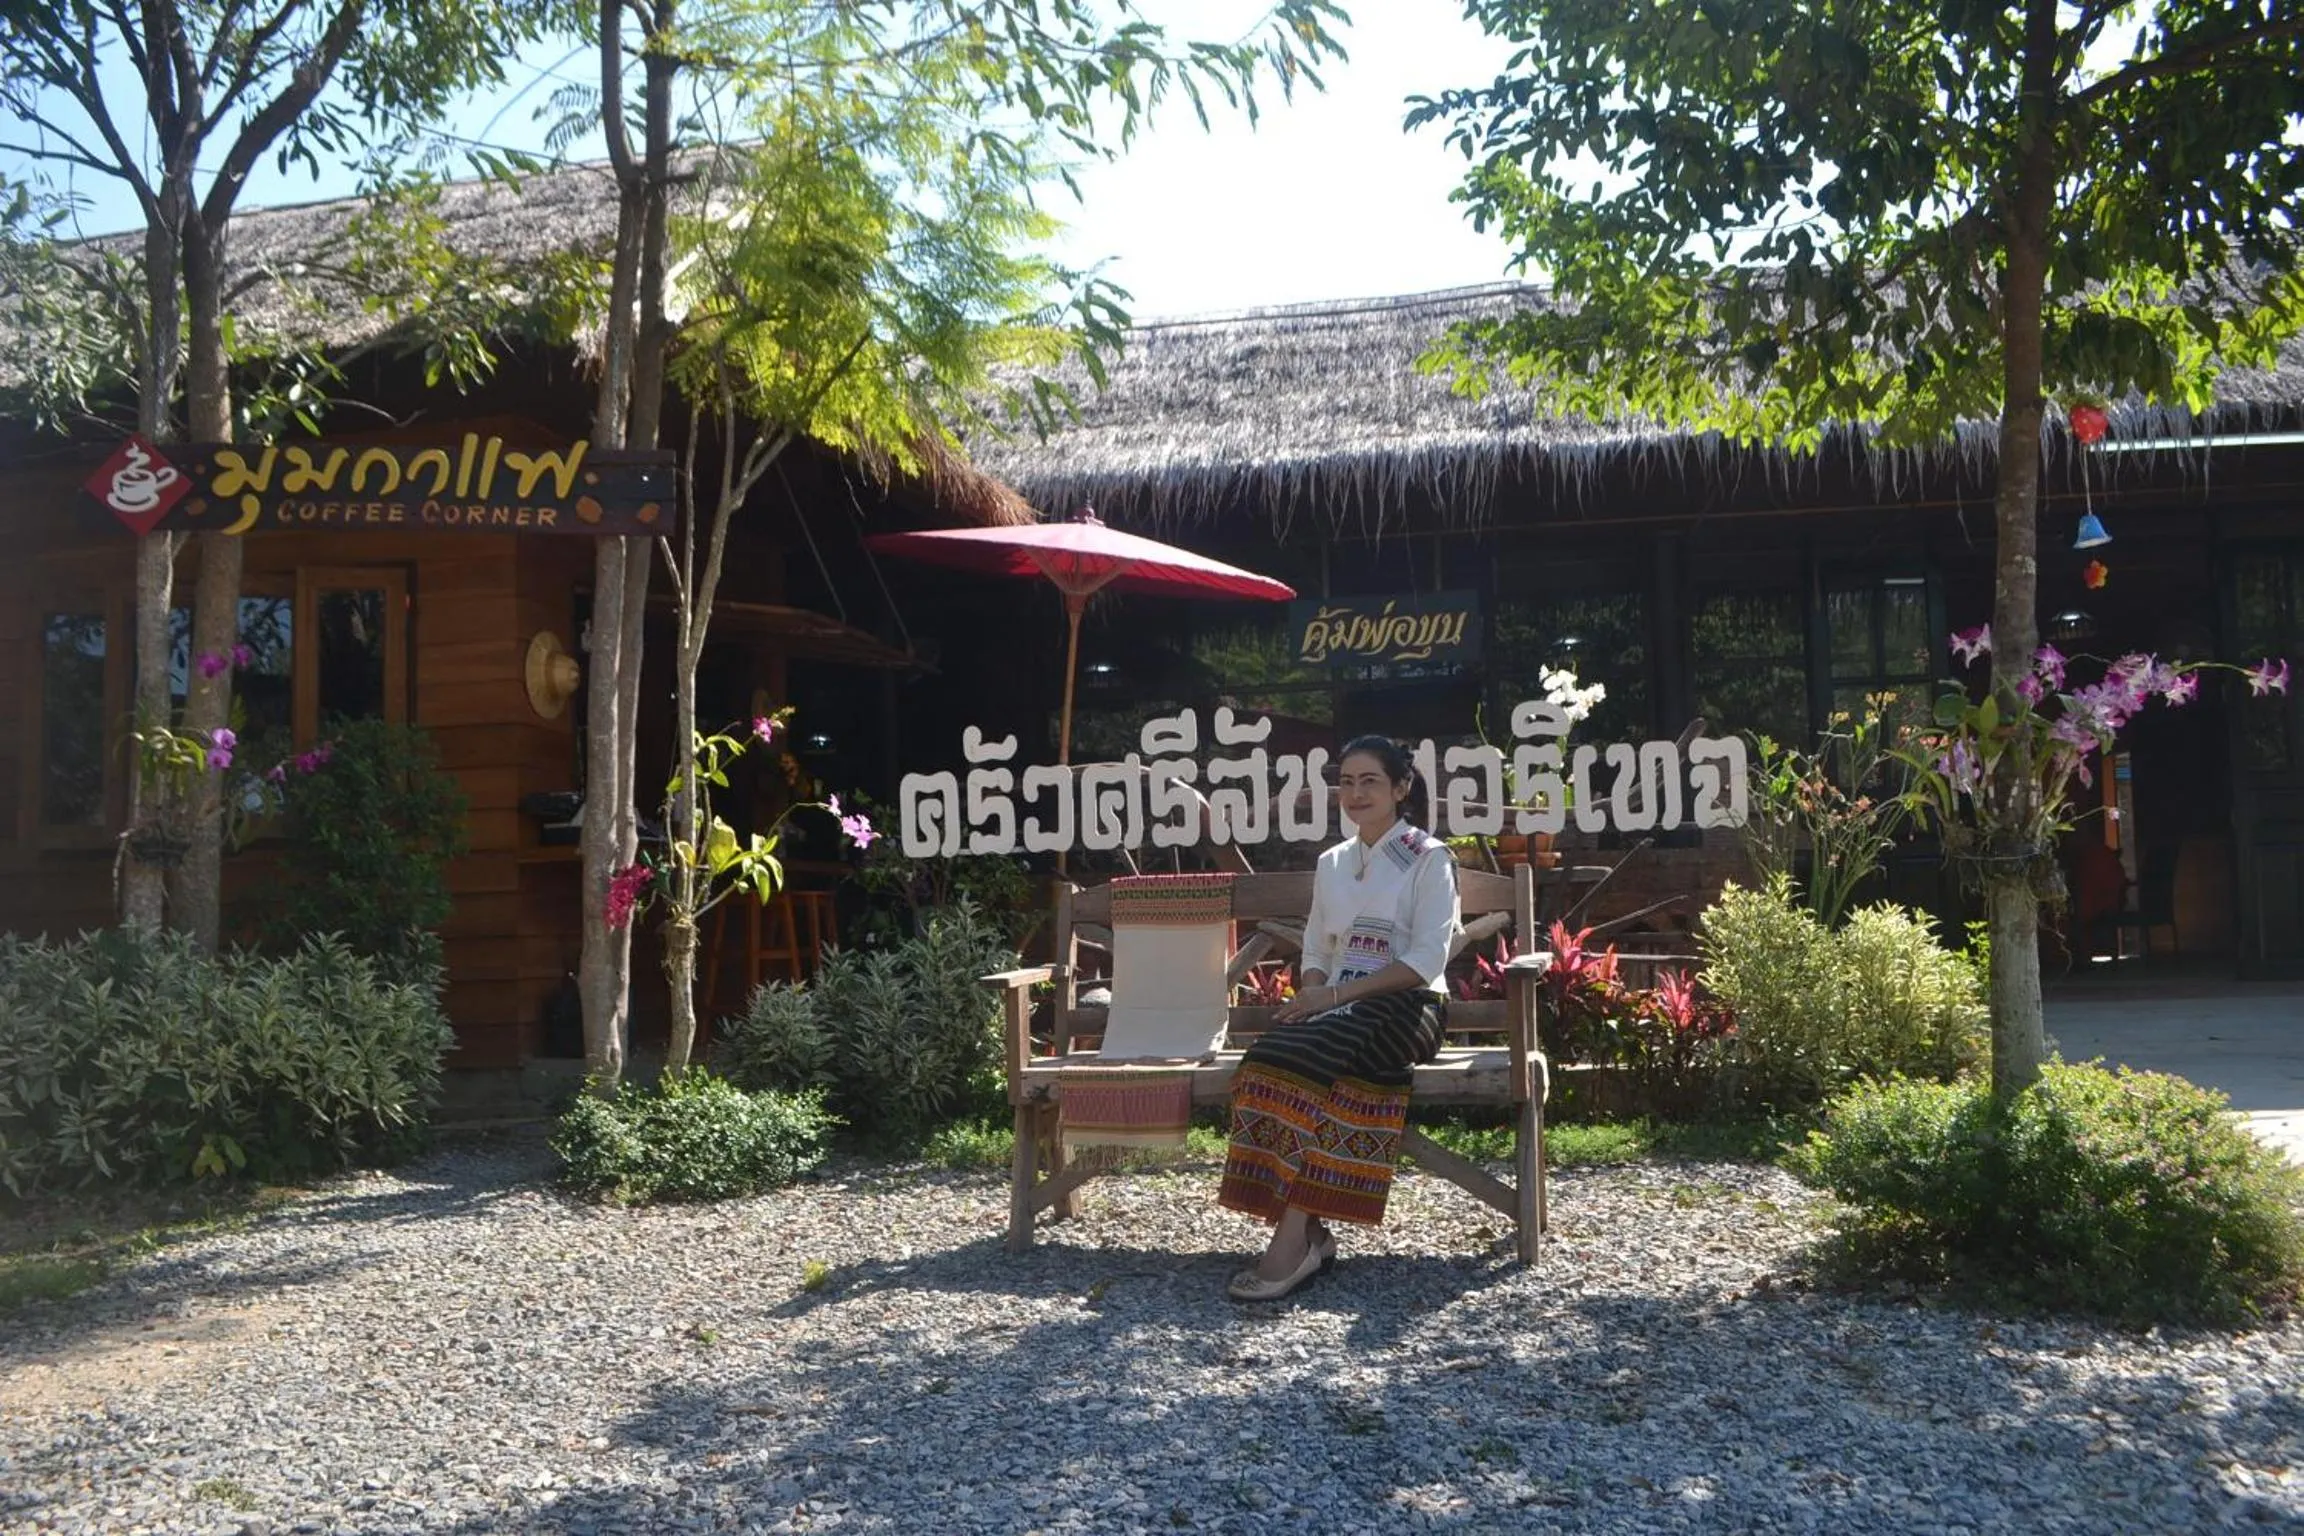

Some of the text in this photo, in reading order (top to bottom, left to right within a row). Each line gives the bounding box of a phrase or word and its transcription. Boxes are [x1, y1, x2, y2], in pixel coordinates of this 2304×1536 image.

[211, 433, 589, 535] มุมกาแฟ
[277, 499, 558, 526] COFFEE CORNER
